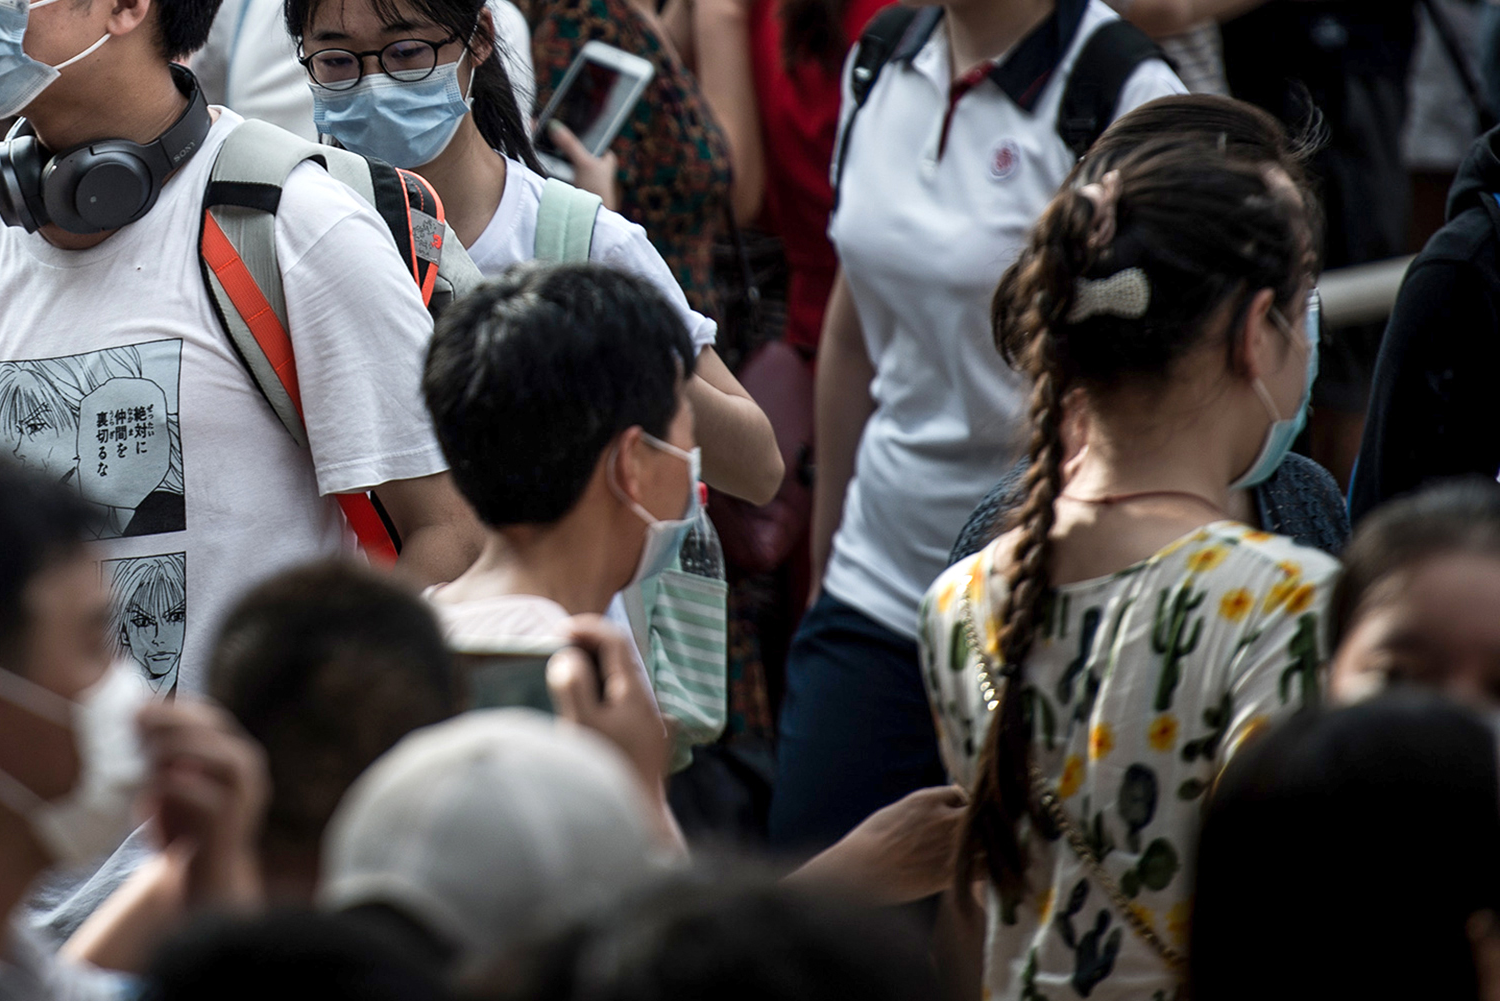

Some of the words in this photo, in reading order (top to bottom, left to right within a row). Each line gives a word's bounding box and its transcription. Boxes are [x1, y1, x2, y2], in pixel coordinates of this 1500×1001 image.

[96, 411, 109, 477] 裏切るな
[114, 408, 128, 458] 仲間を
[133, 406, 148, 454] 絶対に
